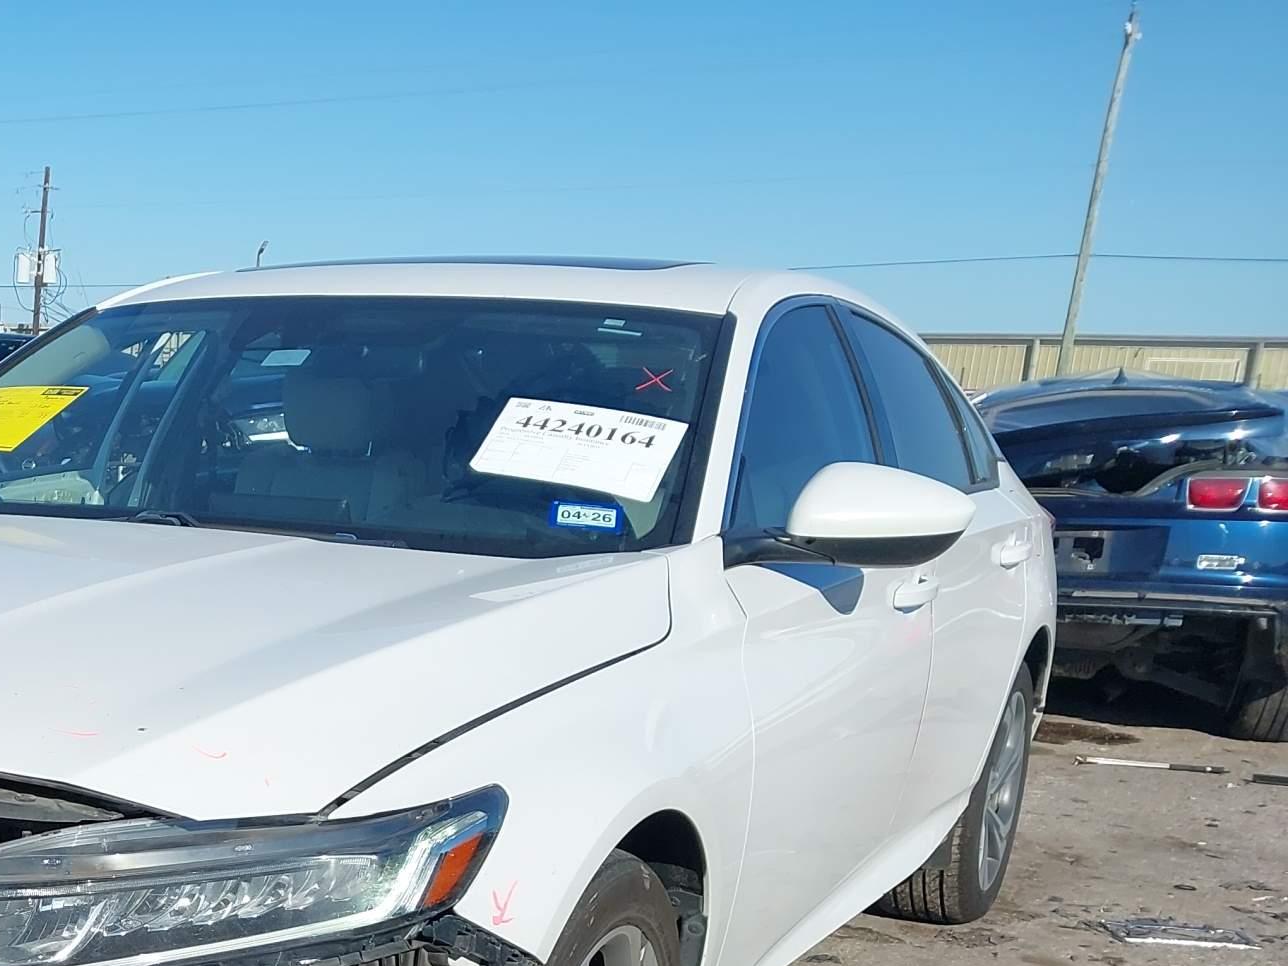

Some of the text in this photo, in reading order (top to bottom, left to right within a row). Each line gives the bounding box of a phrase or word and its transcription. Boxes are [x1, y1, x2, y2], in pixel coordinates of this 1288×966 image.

[515, 414, 656, 449] 44240164
[561, 509, 612, 523] 04 26
